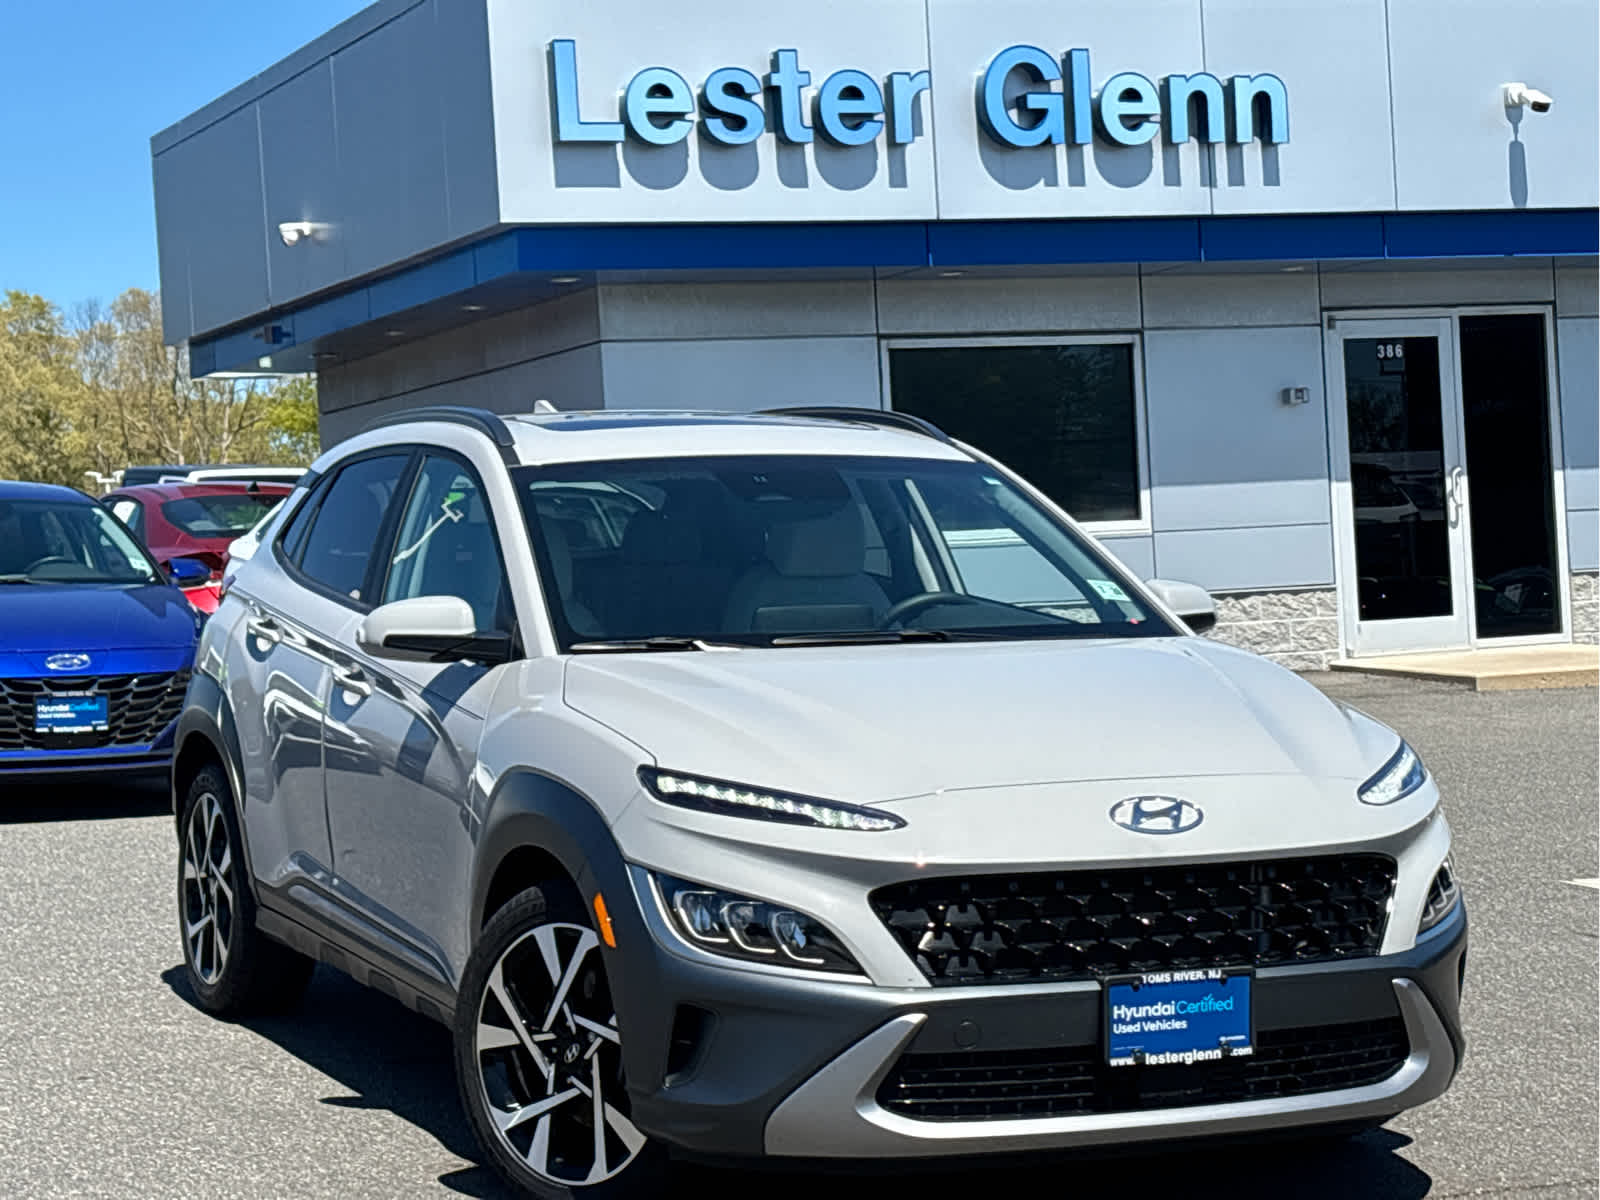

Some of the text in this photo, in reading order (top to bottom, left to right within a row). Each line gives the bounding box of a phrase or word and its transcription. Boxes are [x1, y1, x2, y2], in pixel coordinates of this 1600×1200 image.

[549, 39, 1290, 147] Lester Glenn
[1377, 344, 1403, 358] 386
[1142, 973, 1173, 984] TOMS
[1208, 969, 1222, 979] NJ
[1113, 995, 1233, 1021] Hyundai Certified
[1113, 1019, 1187, 1034] Used Vehicles
[1145, 1049, 1222, 1065] lesterglenn
